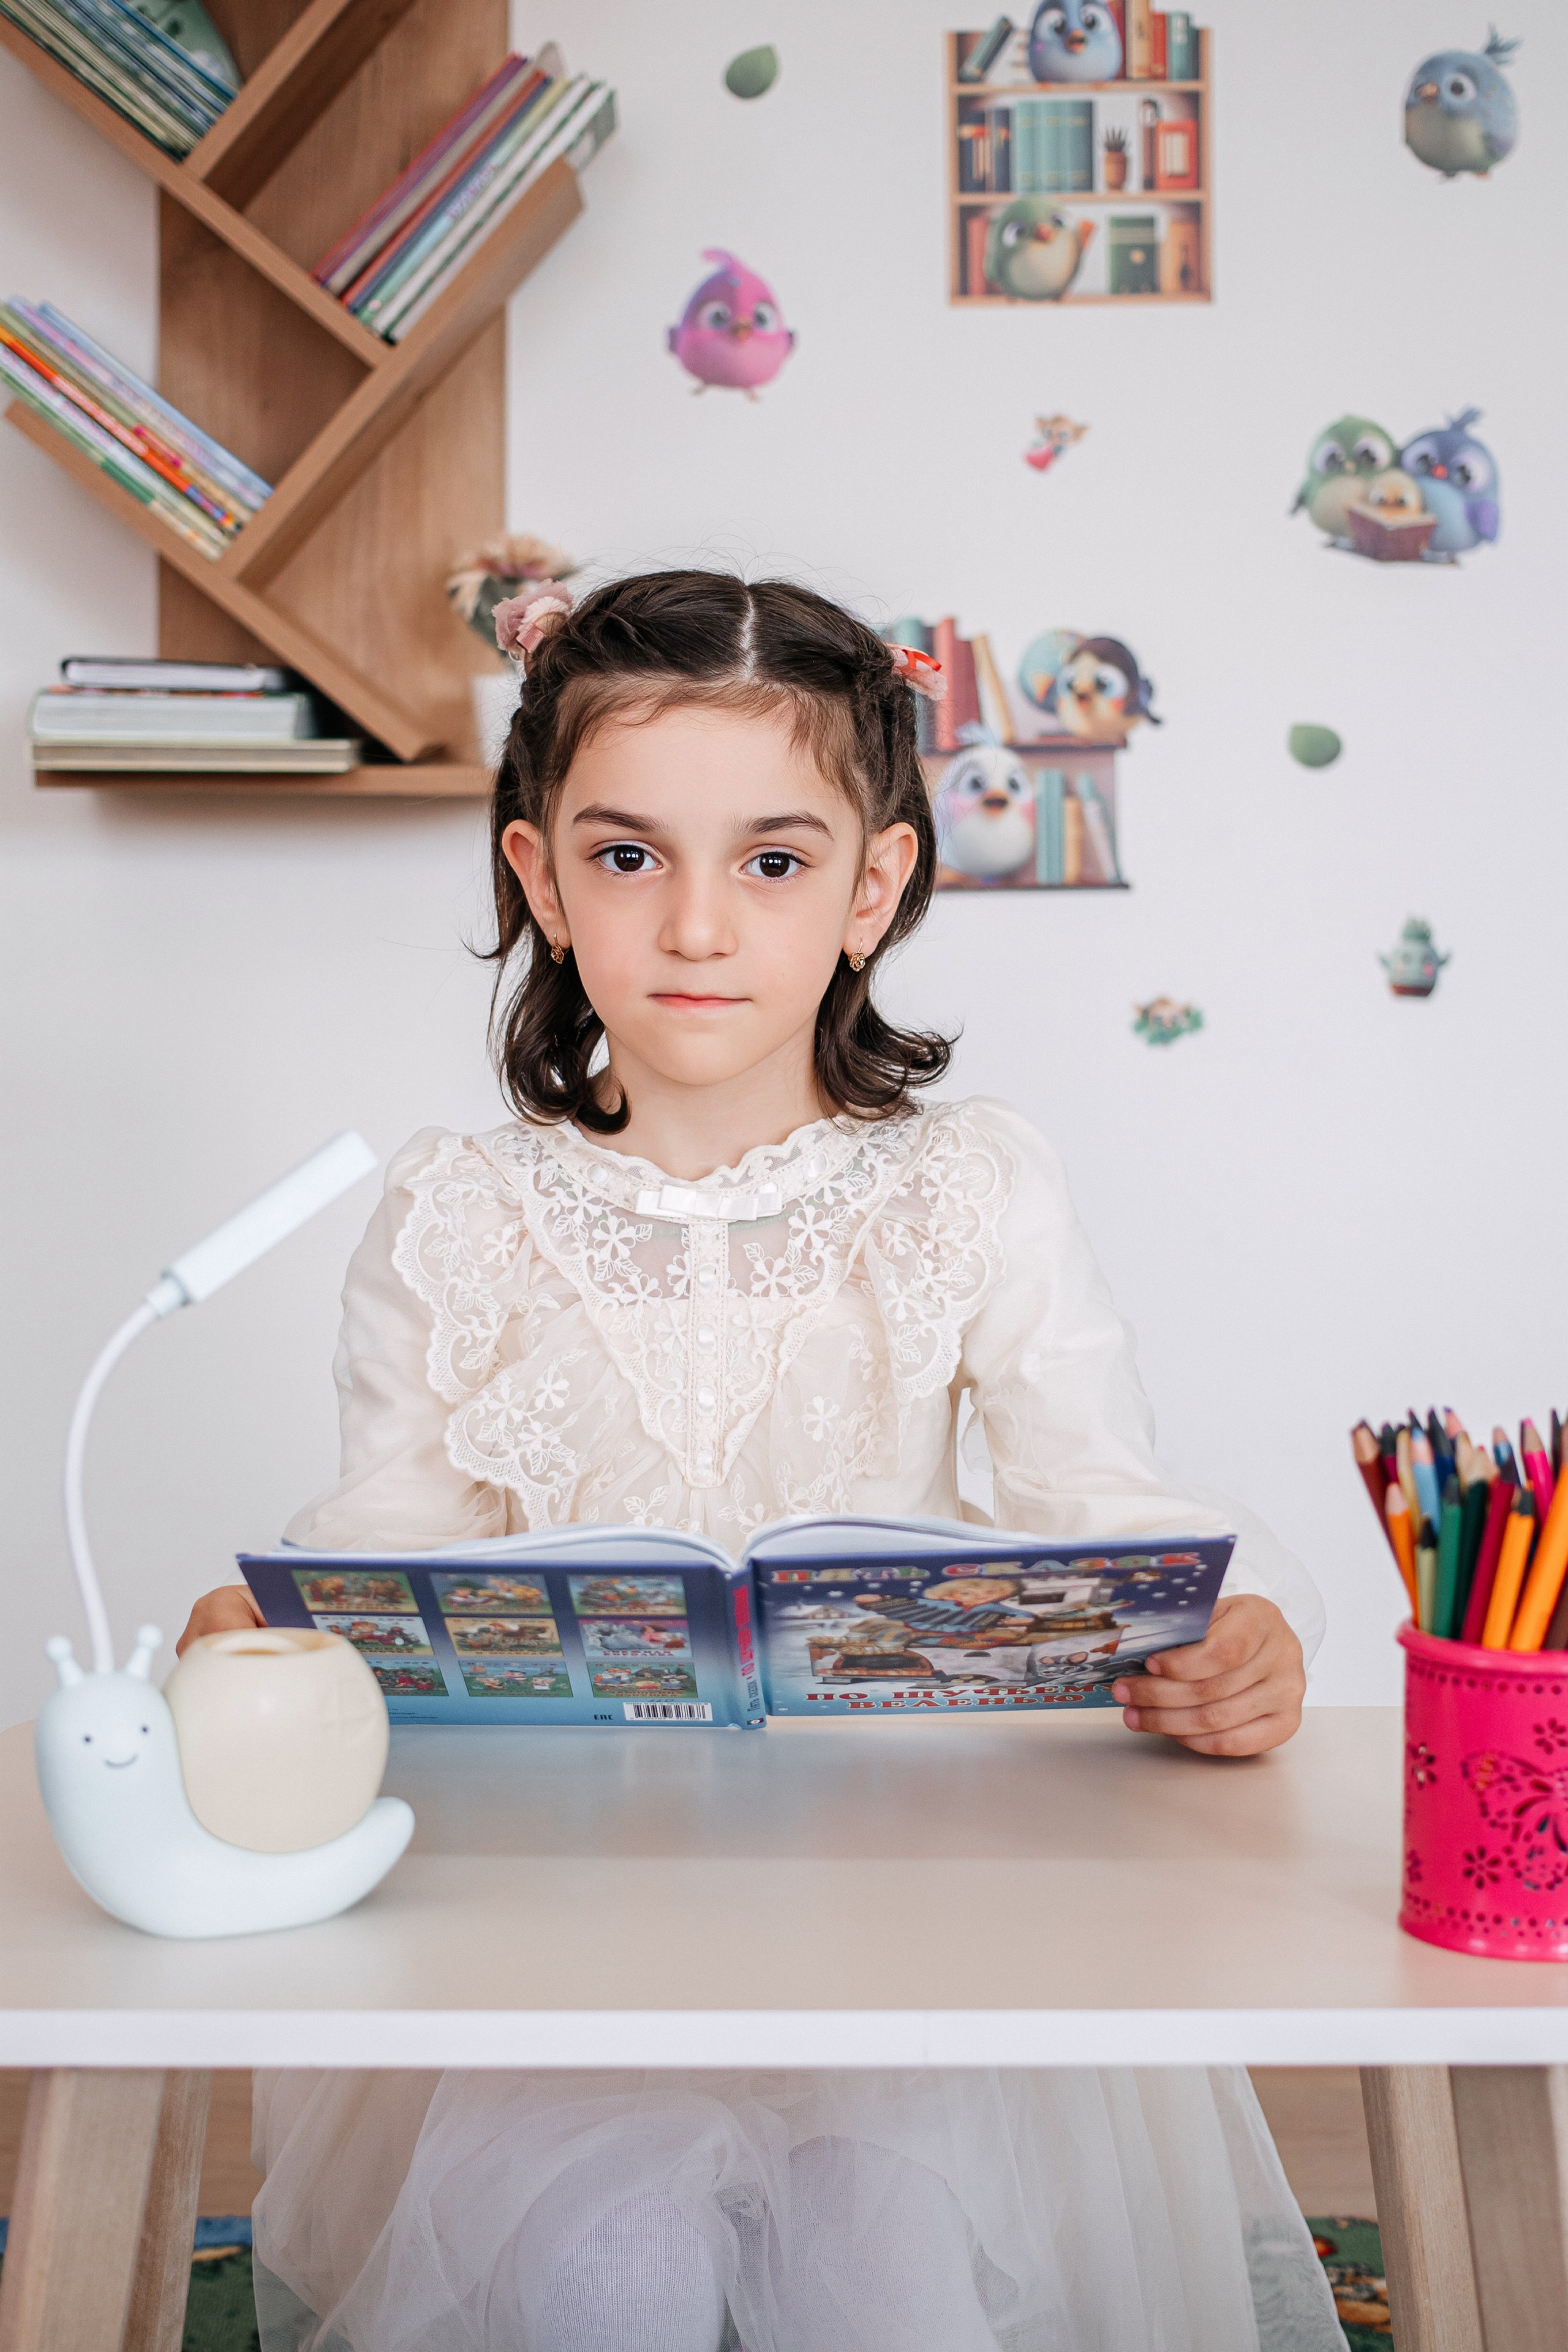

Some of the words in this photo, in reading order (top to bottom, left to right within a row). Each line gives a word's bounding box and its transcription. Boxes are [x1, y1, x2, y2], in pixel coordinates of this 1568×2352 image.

[772, 1566, 930, 1583] ПЯТЬ
[941, 1551, 1200, 1577] СКАЗОК
[847, 1694, 1084, 1709] ВЕЛЕНЬЮ
